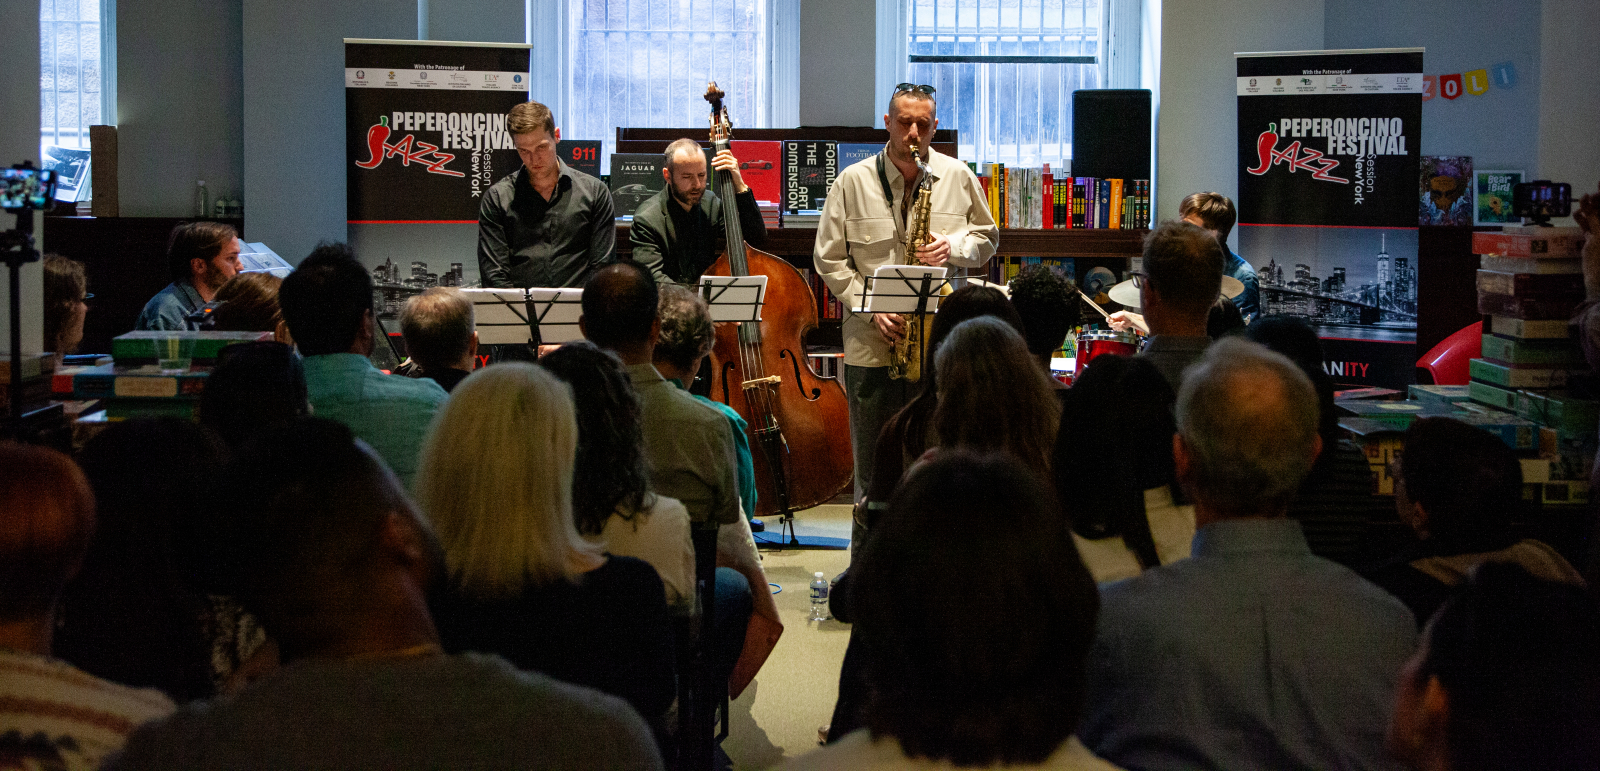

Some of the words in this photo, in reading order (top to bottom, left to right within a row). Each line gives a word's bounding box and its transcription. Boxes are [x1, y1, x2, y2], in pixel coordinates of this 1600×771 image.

[1280, 117, 1403, 137] PEPERONCINO
[442, 131, 517, 150] FESTIVA
[1327, 136, 1408, 155] FESTIVAL
[572, 147, 596, 161] 911
[806, 142, 817, 166] THE
[483, 148, 493, 186] Session
[788, 142, 798, 209] DIMENSION
[825, 143, 836, 195] FORMUL
[1366, 153, 1377, 193] Session
[1488, 174, 1512, 184] Bear
[1491, 183, 1511, 192] Bird
[798, 186, 808, 209] ART
